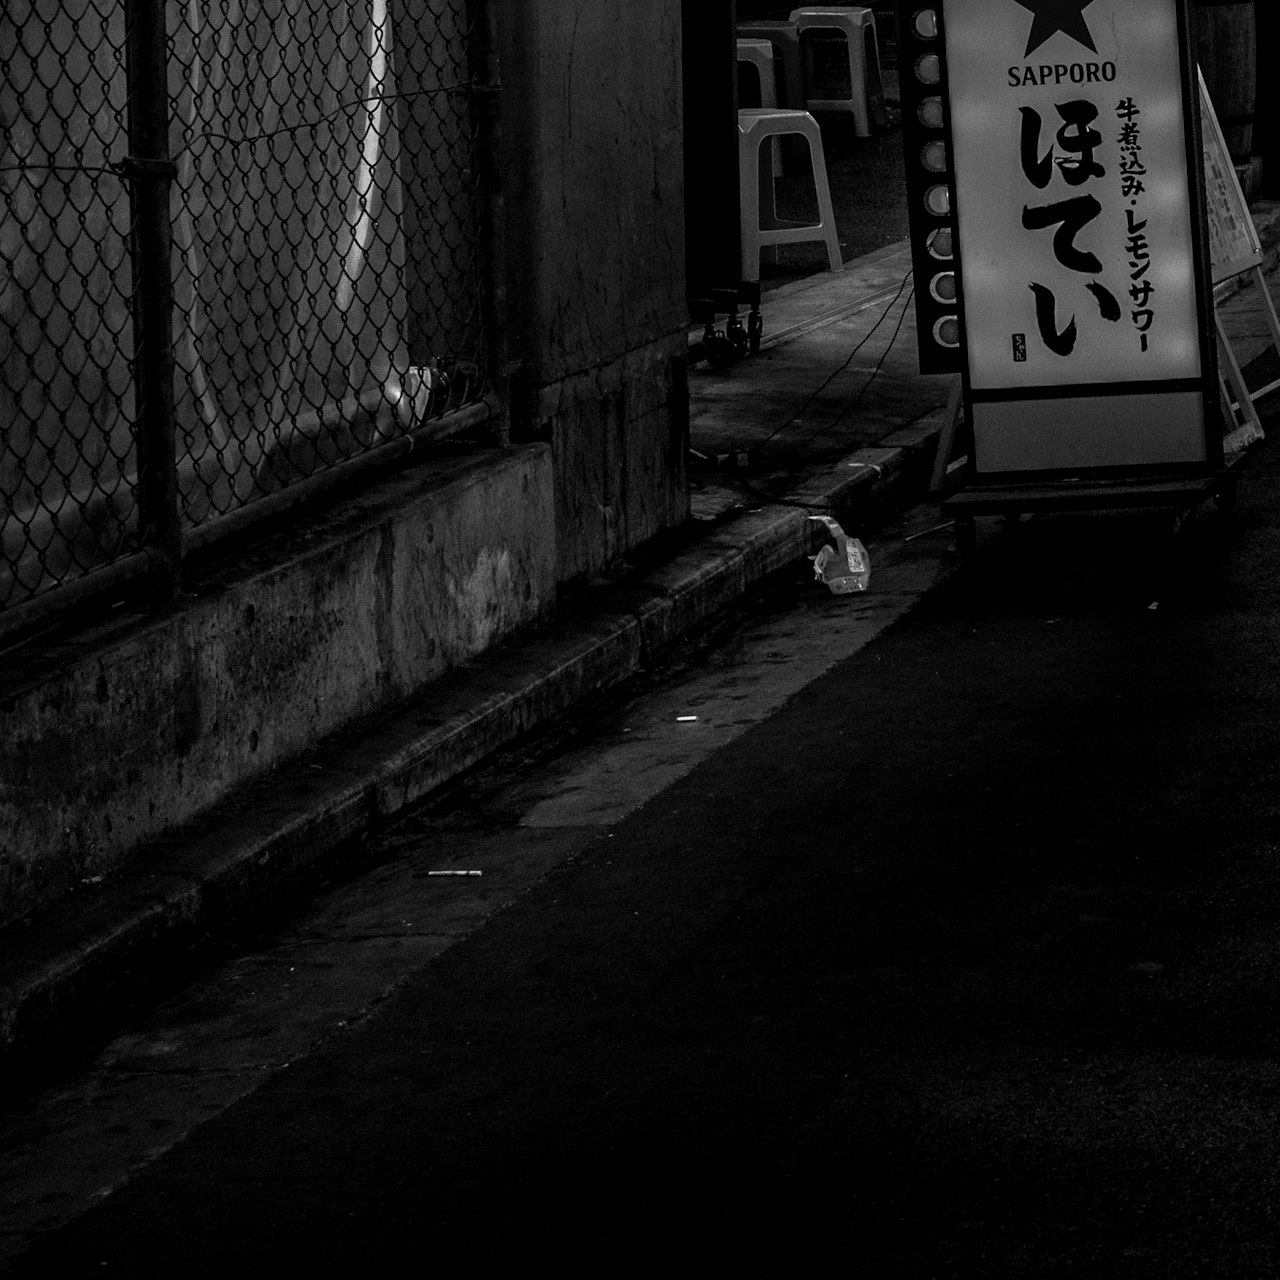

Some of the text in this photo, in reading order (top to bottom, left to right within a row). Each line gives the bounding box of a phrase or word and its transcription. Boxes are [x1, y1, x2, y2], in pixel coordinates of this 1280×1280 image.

[1007, 61, 1117, 88] SAPPORO
[1018, 100, 1122, 357] ほてい
[1115, 97, 1155, 352] 牛煮込み・レモンサワー
